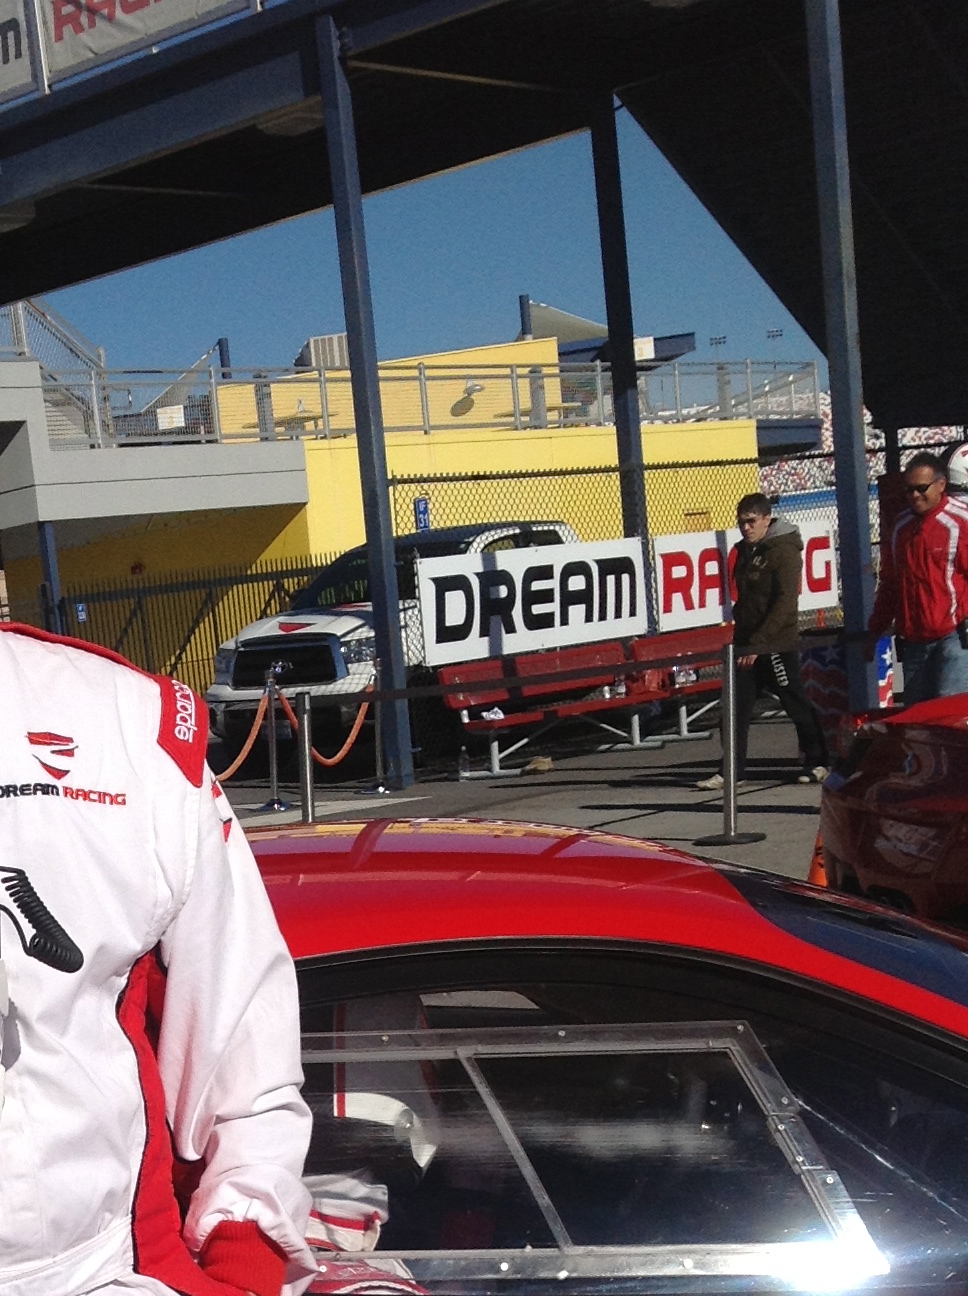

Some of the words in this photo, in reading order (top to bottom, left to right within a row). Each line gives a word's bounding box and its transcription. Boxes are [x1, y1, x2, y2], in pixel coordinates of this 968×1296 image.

[428, 556, 637, 644] DREAM
[659, 535, 832, 614] RAG
[770, 652, 789, 687] LLISTER
[62, 785, 126, 806] RACING
